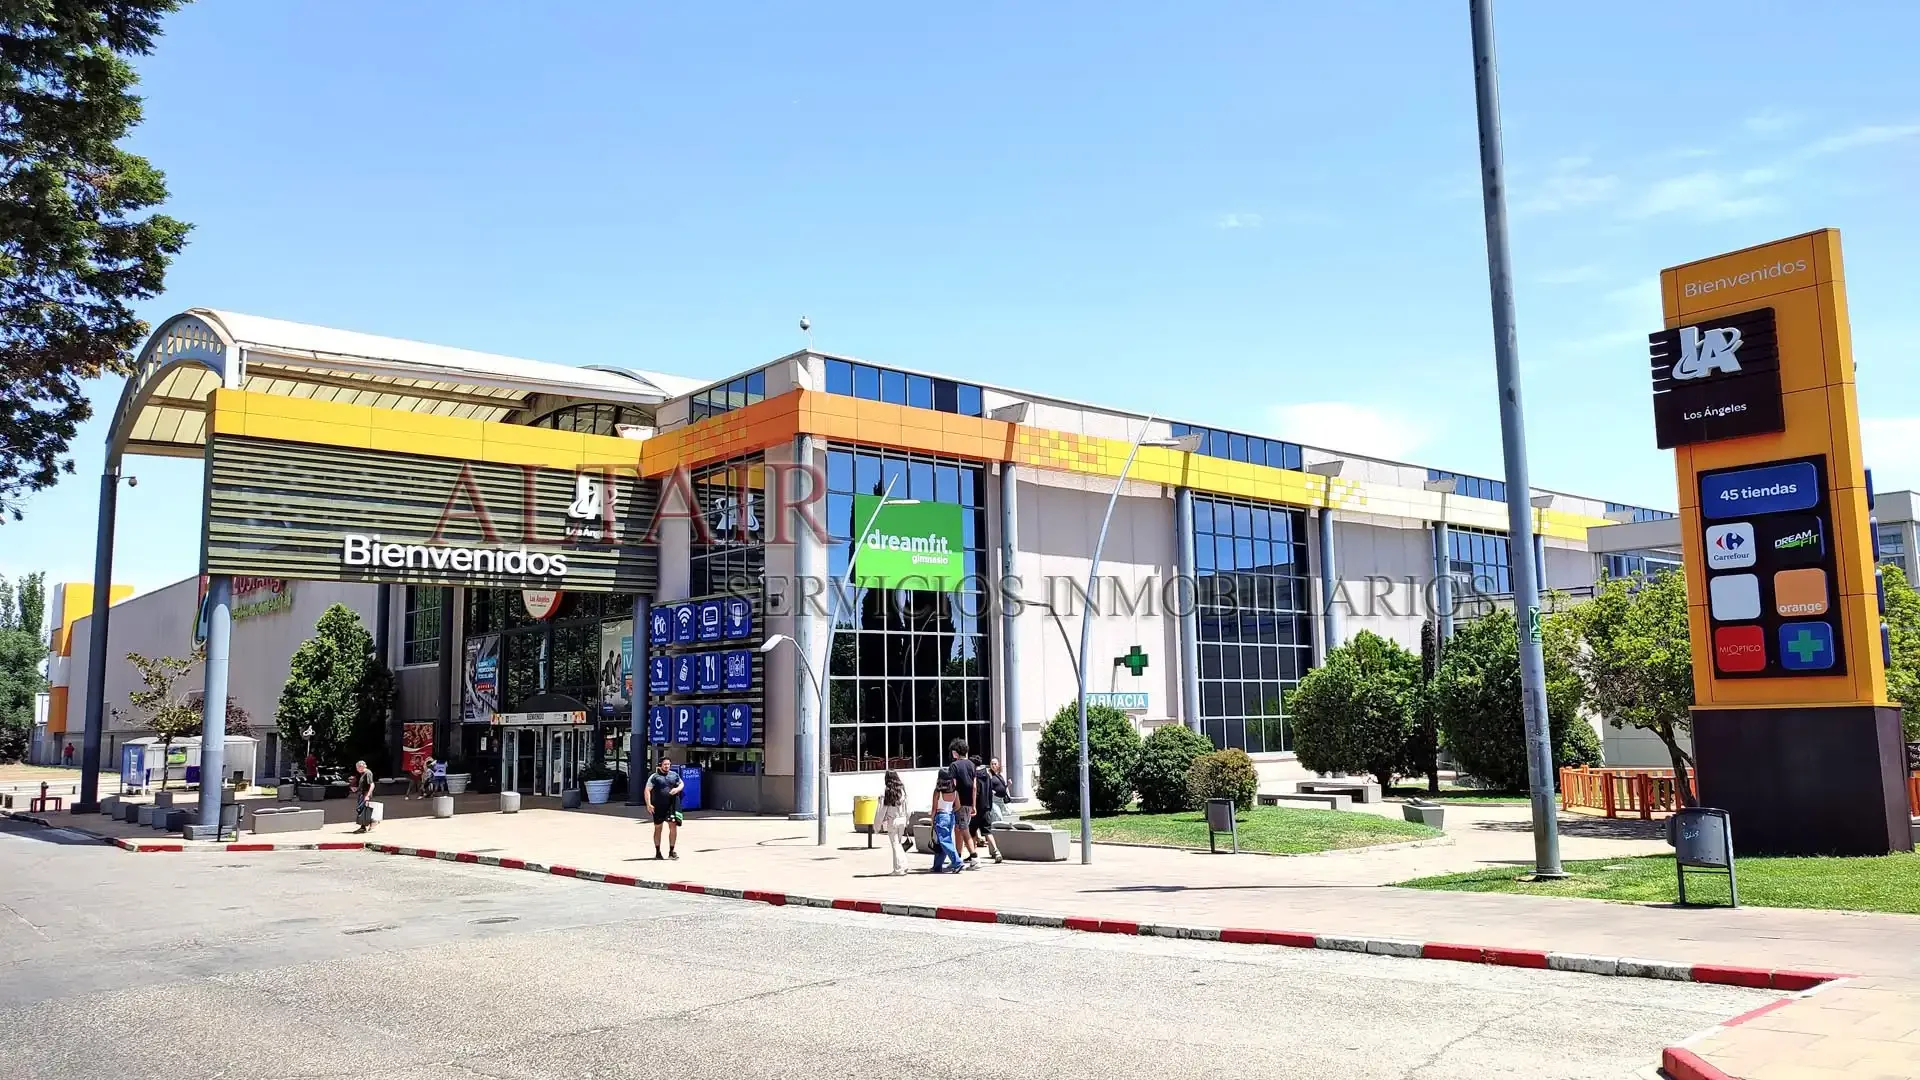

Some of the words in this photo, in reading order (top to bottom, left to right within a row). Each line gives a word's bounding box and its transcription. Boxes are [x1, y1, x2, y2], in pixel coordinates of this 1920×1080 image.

[1684, 259, 1807, 298] Bienvenidos
[1683, 410, 1702, 421] Los
[1704, 403, 1747, 417] Ángeles
[1720, 488, 1739, 501] 45
[1741, 483, 1797, 499] tiendas
[1774, 529, 1812, 548] DREAM
[1800, 534, 1820, 548] FIT
[343, 533, 568, 577] Bienvenidos
[911, 554, 949, 565] gimnasio
[1713, 552, 1750, 561] Carrefour
[1779, 602, 1823, 613] orange
